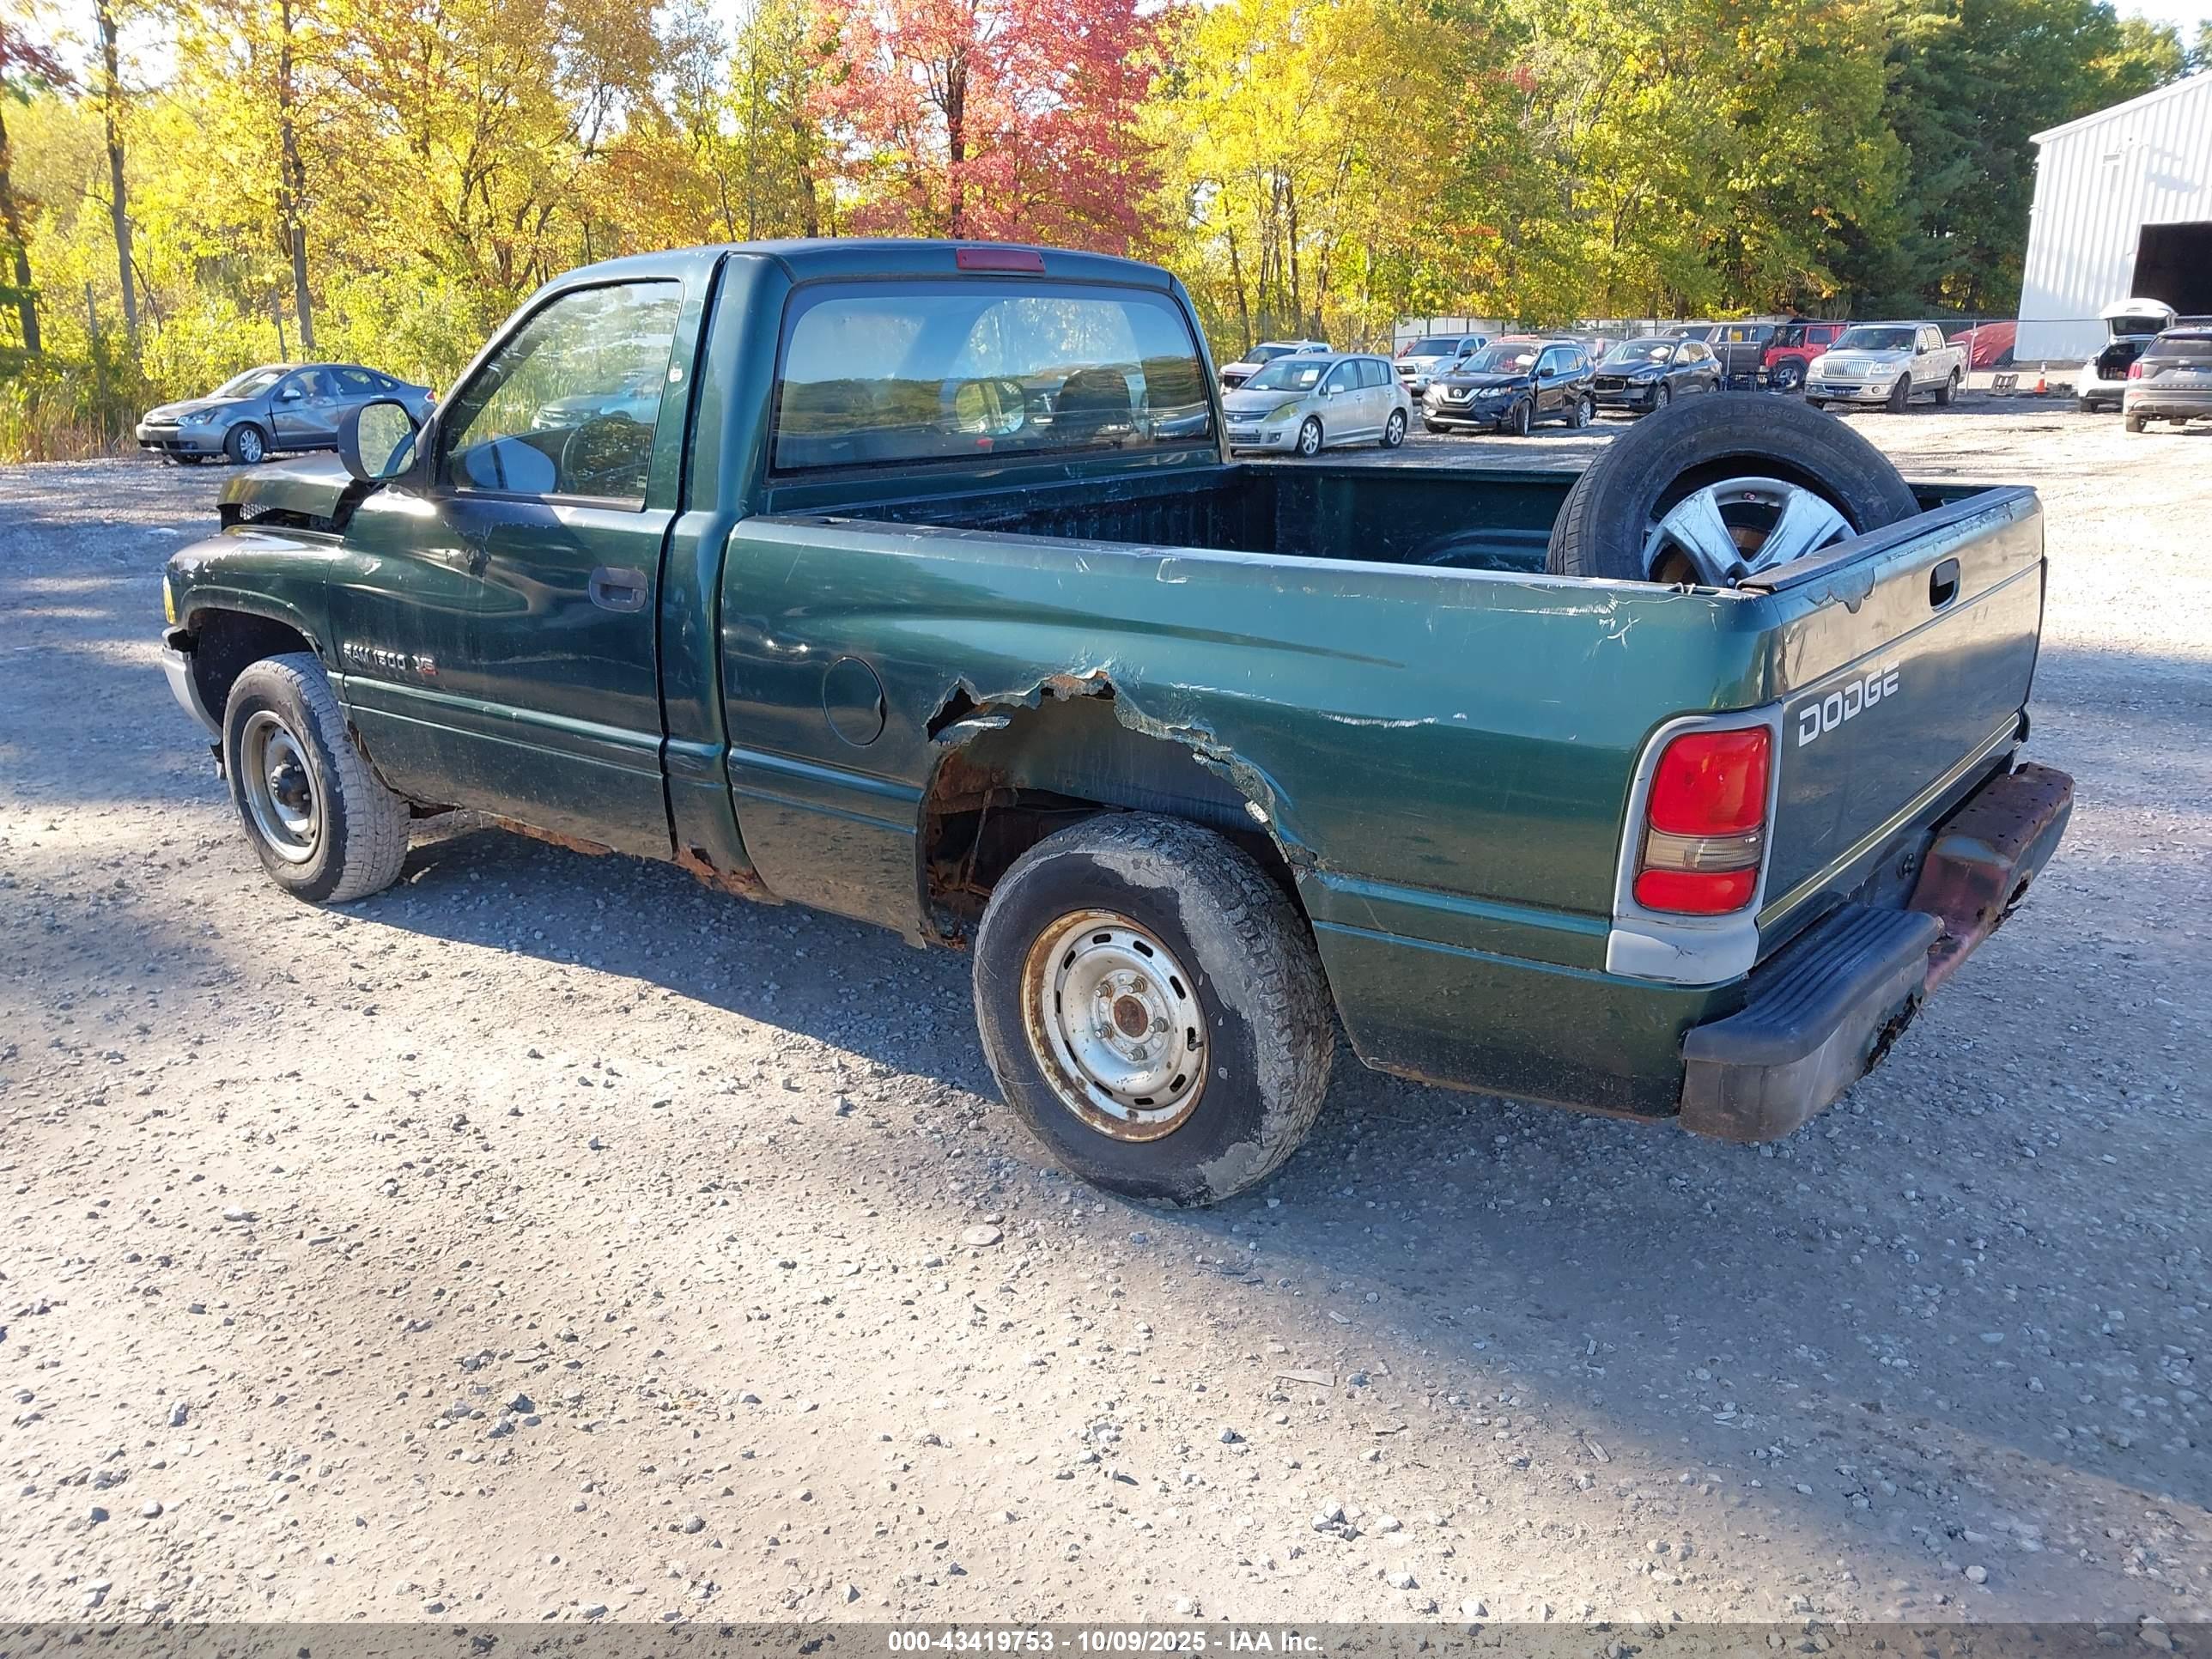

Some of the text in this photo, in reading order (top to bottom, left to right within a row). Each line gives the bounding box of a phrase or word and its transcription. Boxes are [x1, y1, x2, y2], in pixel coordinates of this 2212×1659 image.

[343, 642, 369, 663] RAM
[373, 649, 406, 671] 1500
[1798, 659, 1899, 748] DODGE
